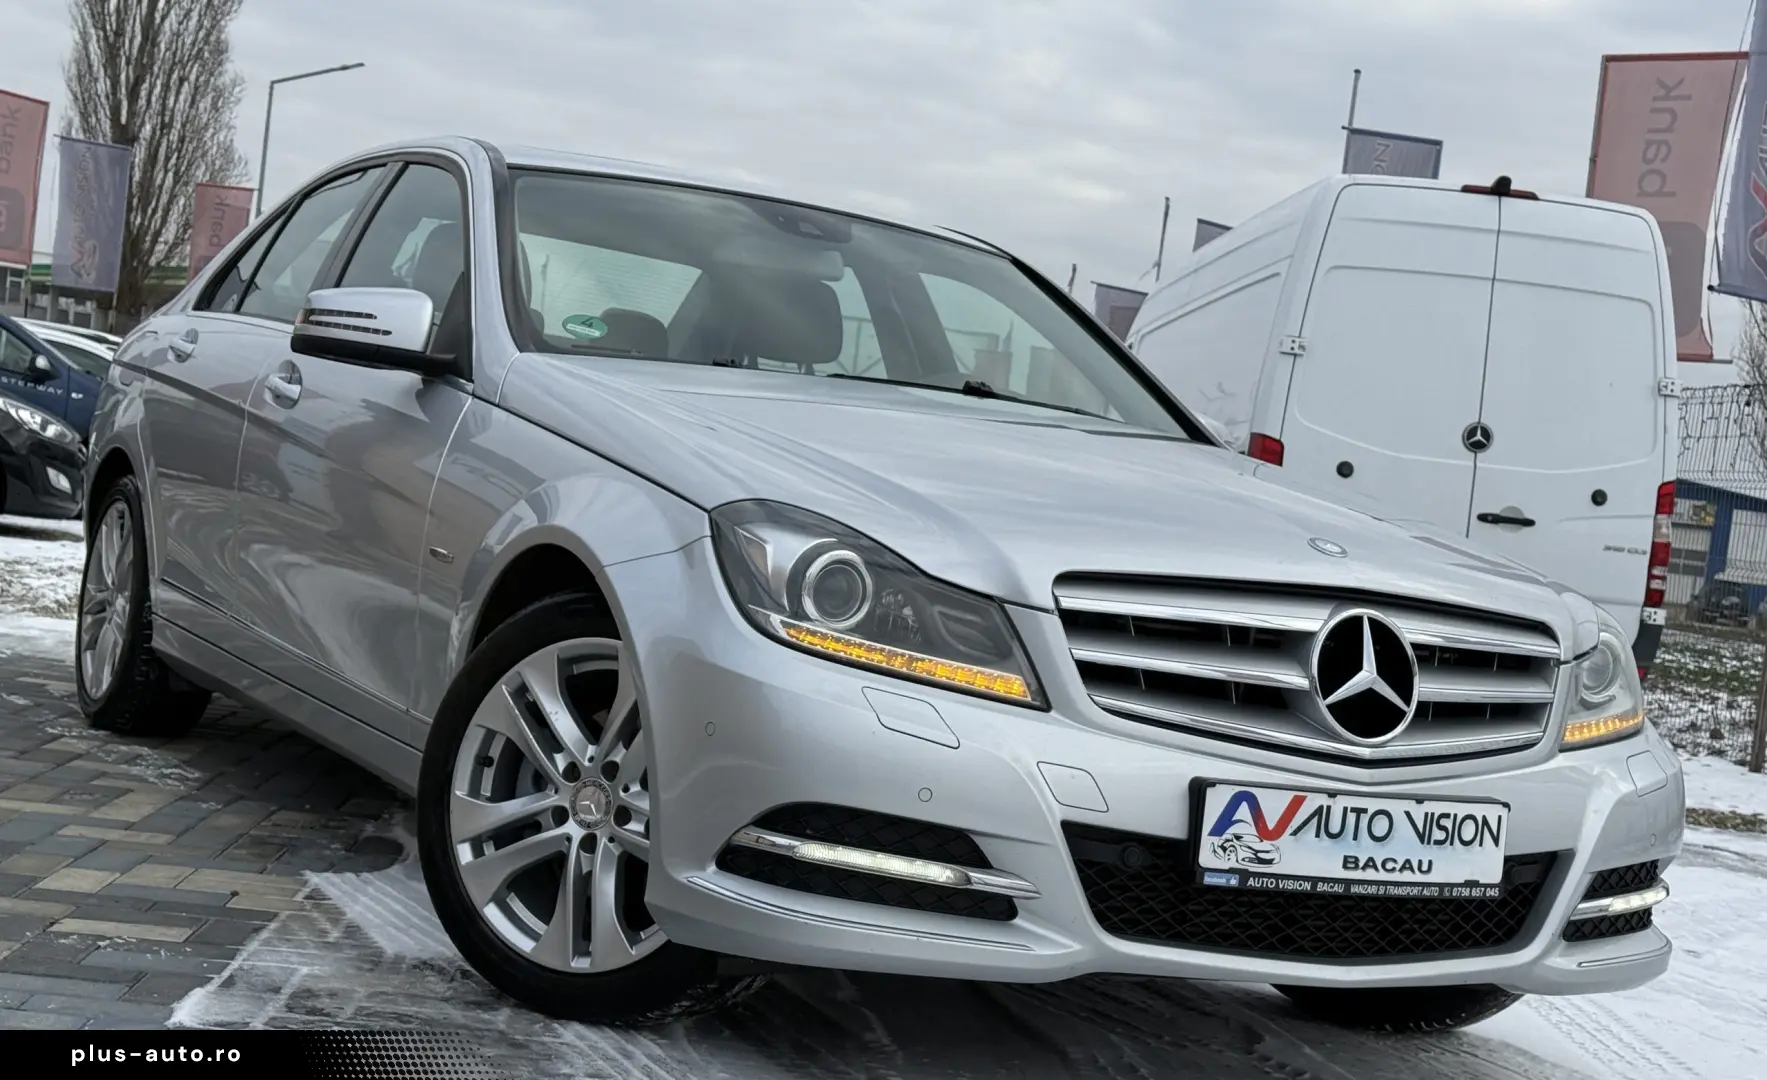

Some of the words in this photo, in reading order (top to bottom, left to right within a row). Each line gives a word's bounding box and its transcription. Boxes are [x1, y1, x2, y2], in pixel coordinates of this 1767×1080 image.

[1289, 804, 1394, 843] AUTO
[1404, 809, 1503, 848] VISION
[1341, 855, 1433, 875] BACAU
[1247, 877, 1276, 888] AUTO
[1278, 879, 1312, 891] VISION
[1316, 882, 1345, 893] BACAU
[1350, 884, 1378, 895] VANZARI
[1378, 885, 1385, 895] SI
[1385, 886, 1423, 896] TRANSPORT
[1422, 887, 1439, 896] AUTO
[1452, 887, 1470, 897] 0758
[1471, 887, 1485, 897] 657
[1485, 887, 1500, 897] 045
